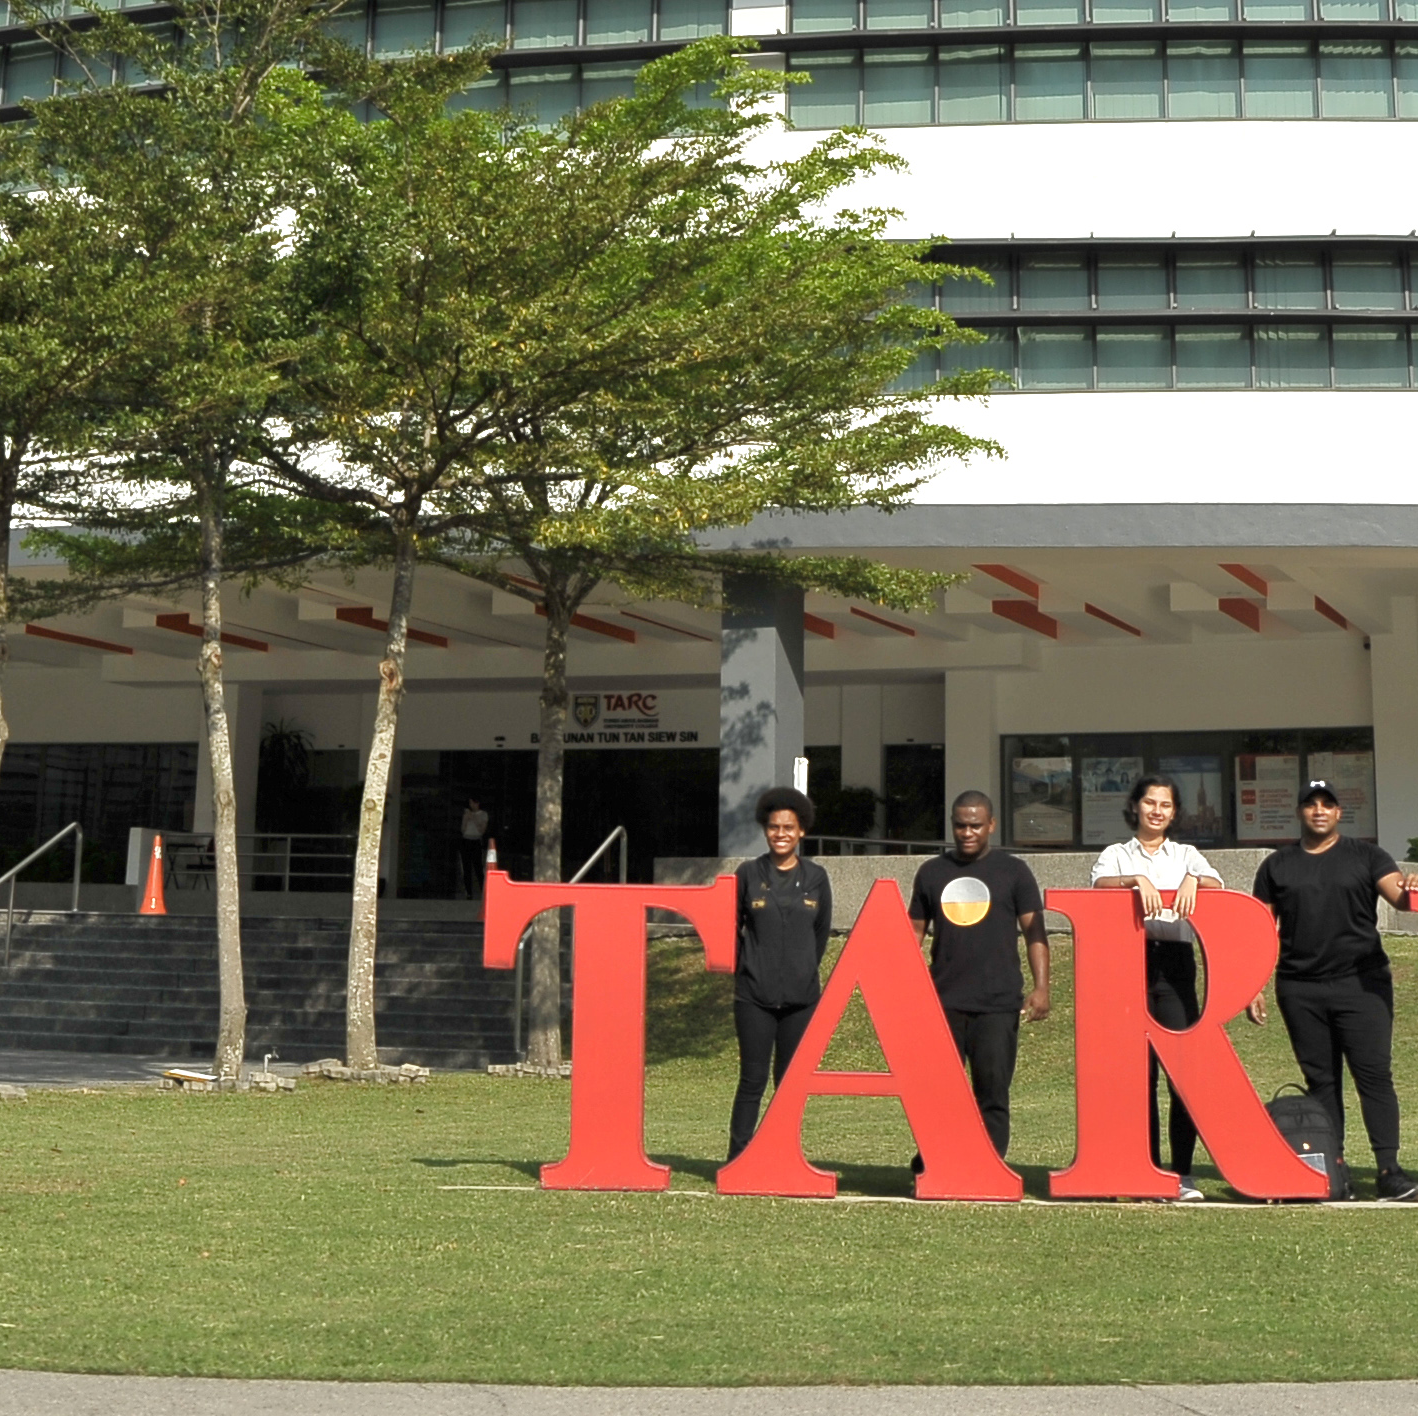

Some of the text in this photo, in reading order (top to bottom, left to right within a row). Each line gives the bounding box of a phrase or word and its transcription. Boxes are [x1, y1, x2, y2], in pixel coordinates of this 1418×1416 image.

[604, 693, 659, 717] TARC
[598, 732, 621, 743] TUN
[623, 732, 645, 743] TAN
[648, 731, 677, 743] SIEW
[680, 731, 698, 742] SIN
